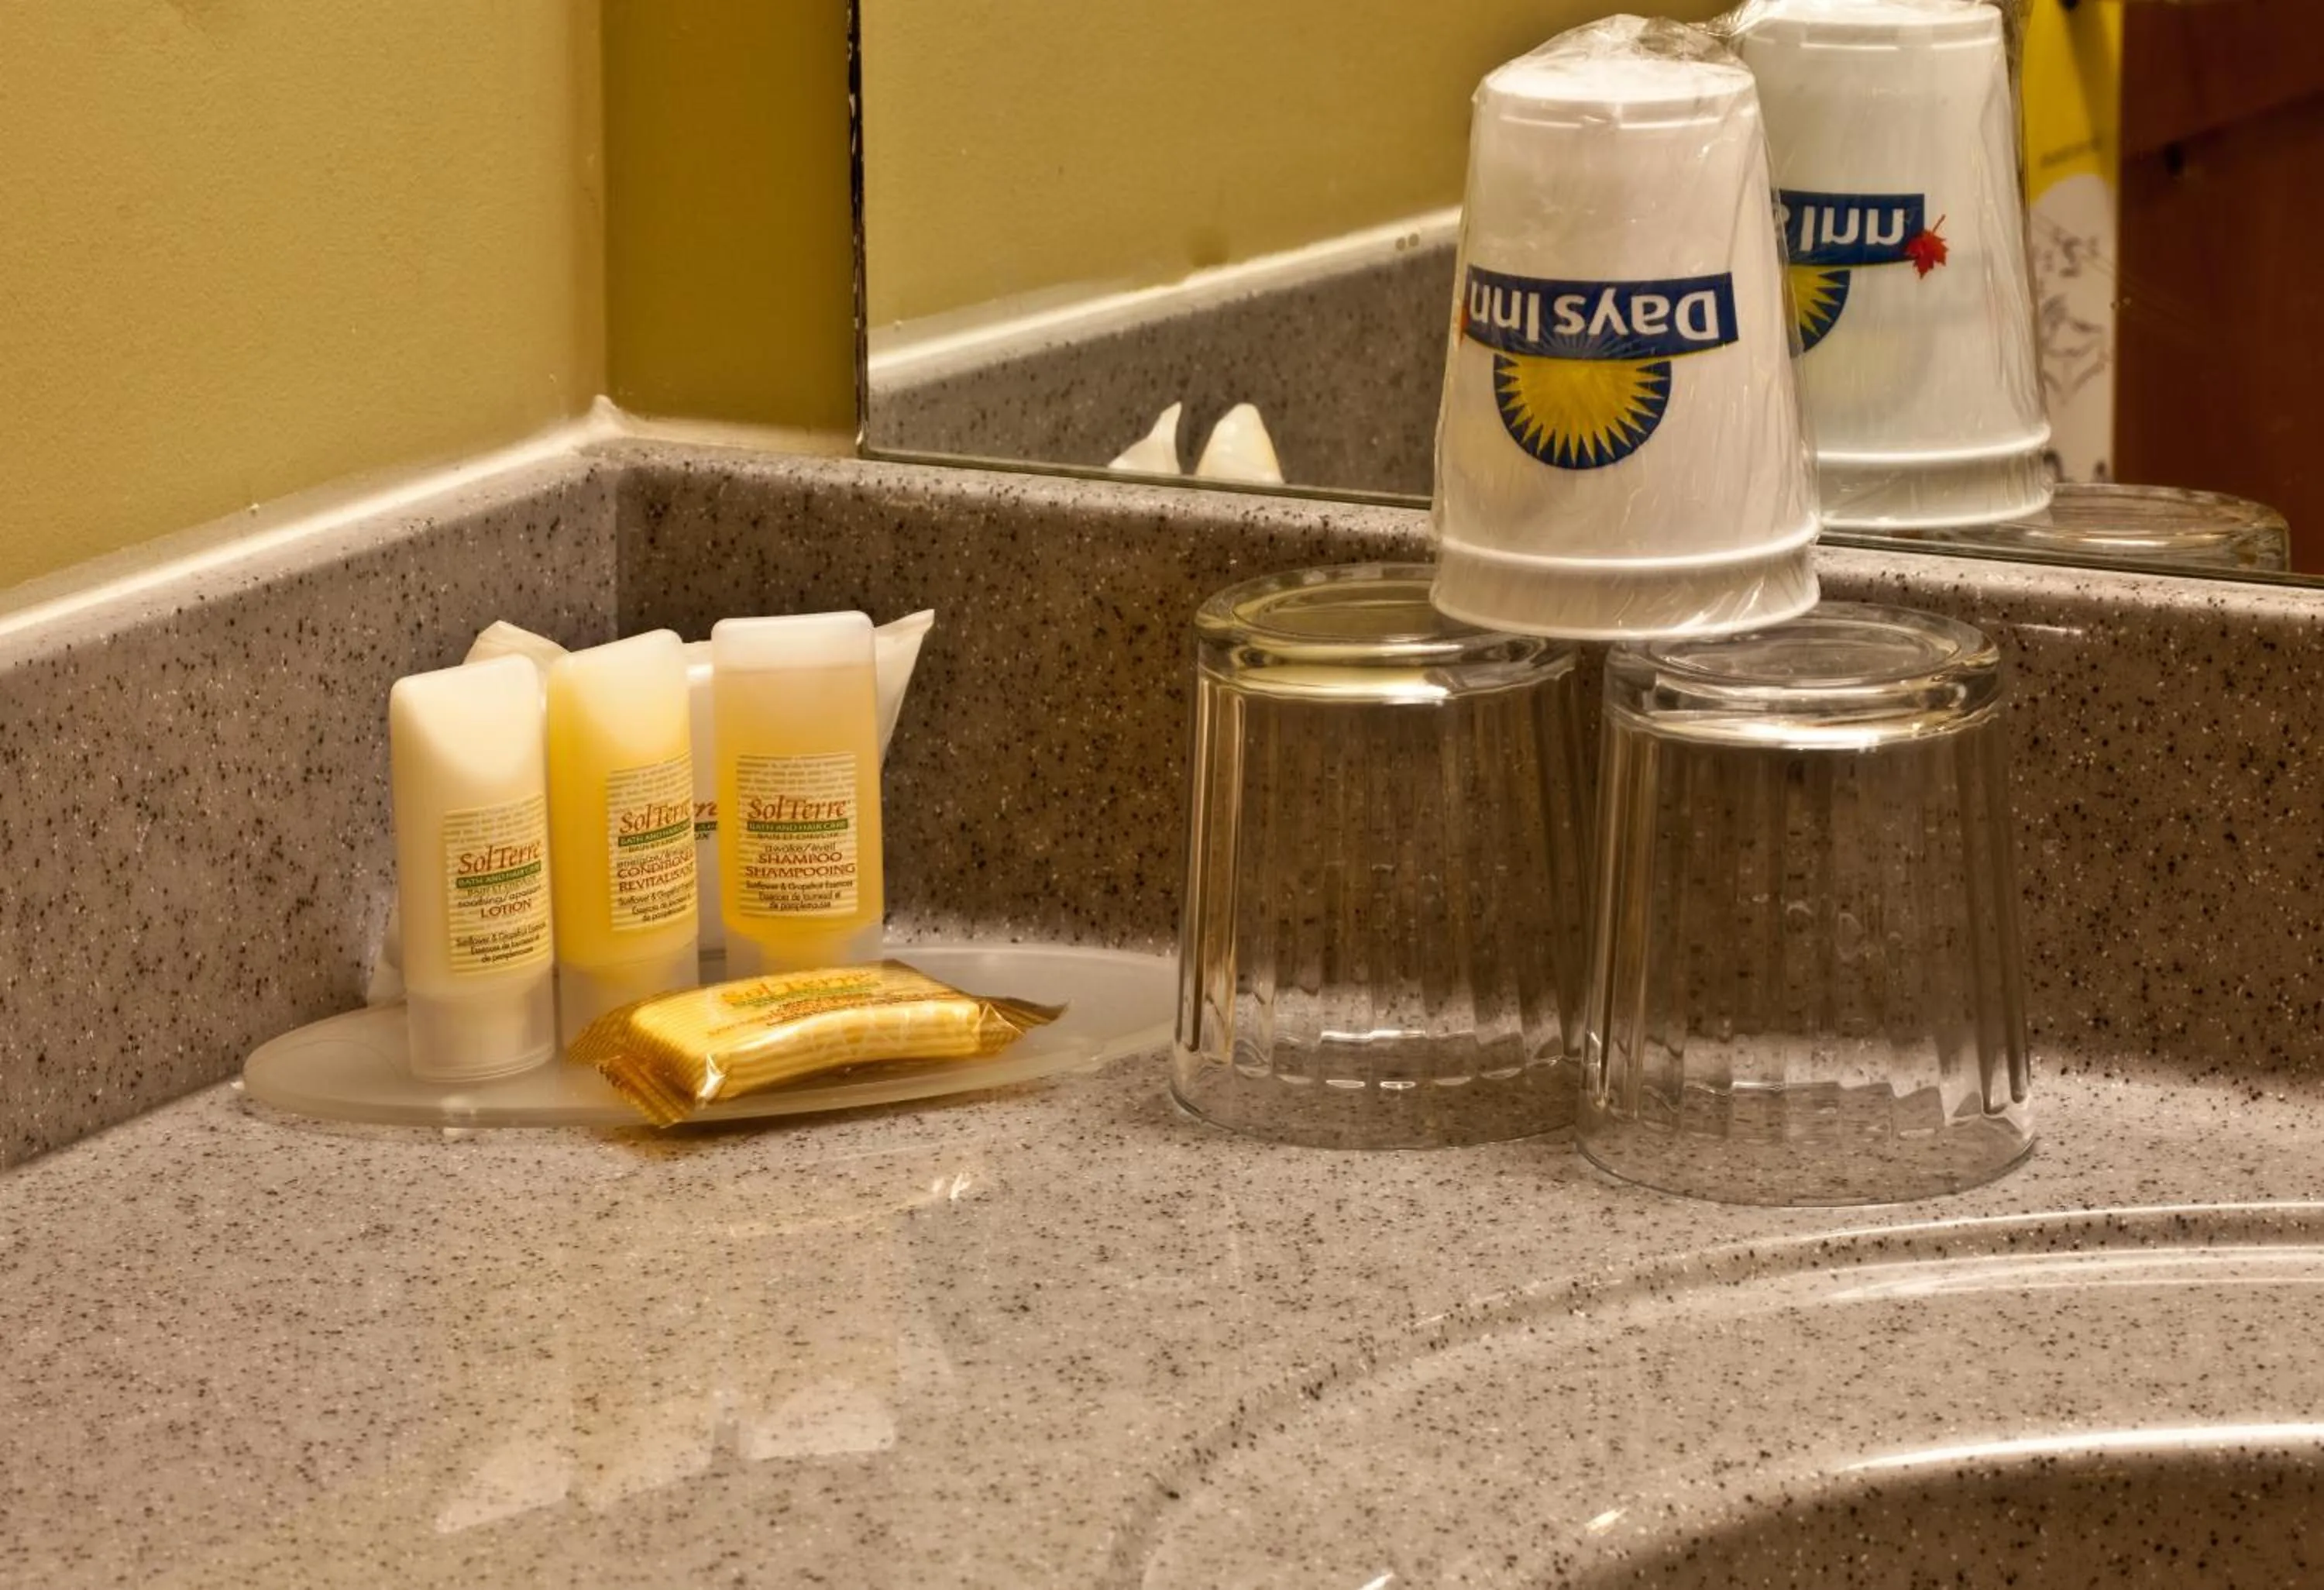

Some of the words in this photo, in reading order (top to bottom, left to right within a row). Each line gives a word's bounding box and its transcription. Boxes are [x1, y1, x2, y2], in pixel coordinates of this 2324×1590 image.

[1470, 280, 1540, 342] Inn
[1552, 287, 1720, 342] Days
[758, 852, 843, 864] SHAMPOO
[744, 863, 856, 877] SHAMPOOING
[480, 899, 531, 918] LOTION
